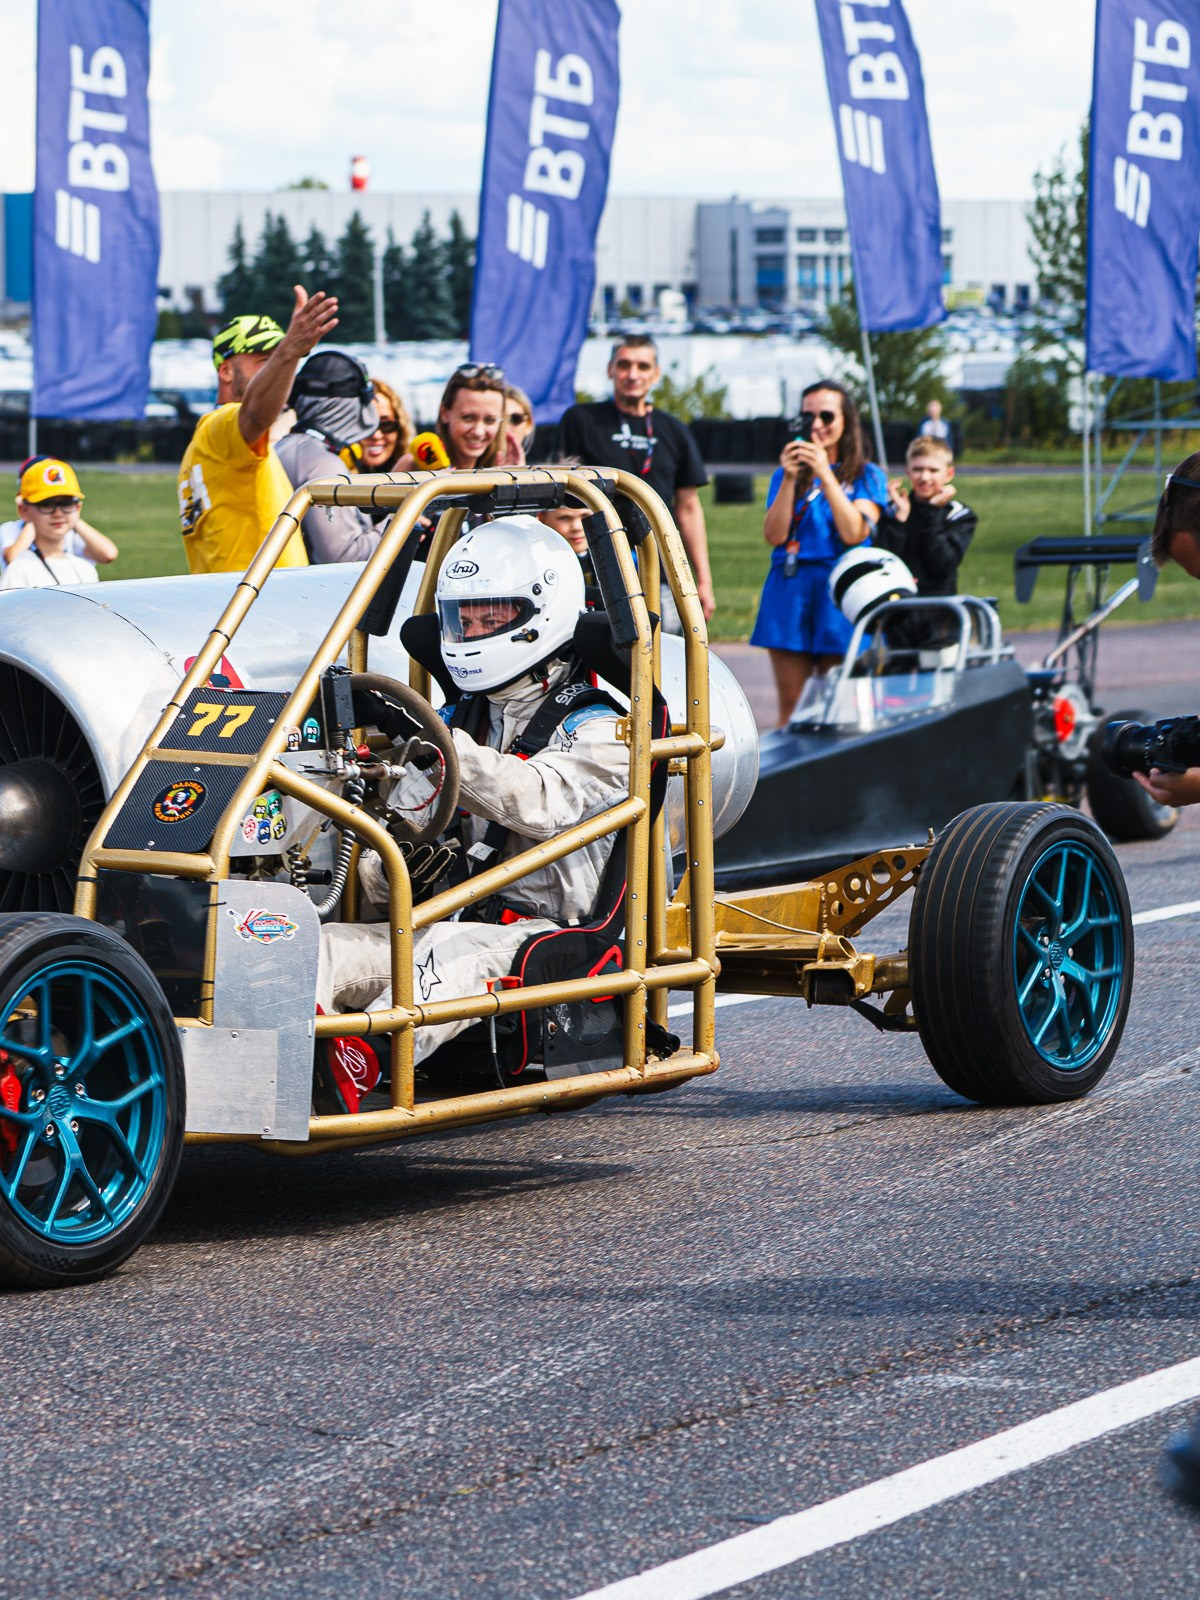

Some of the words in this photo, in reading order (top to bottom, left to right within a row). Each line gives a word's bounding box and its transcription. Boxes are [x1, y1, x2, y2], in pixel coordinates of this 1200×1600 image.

[68, 45, 130, 192] ВТБ
[839, 0, 910, 100] ВТ
[1126, 17, 1191, 161] ВТБ
[523, 48, 594, 200] ВТБ
[187, 702, 257, 738] 77
